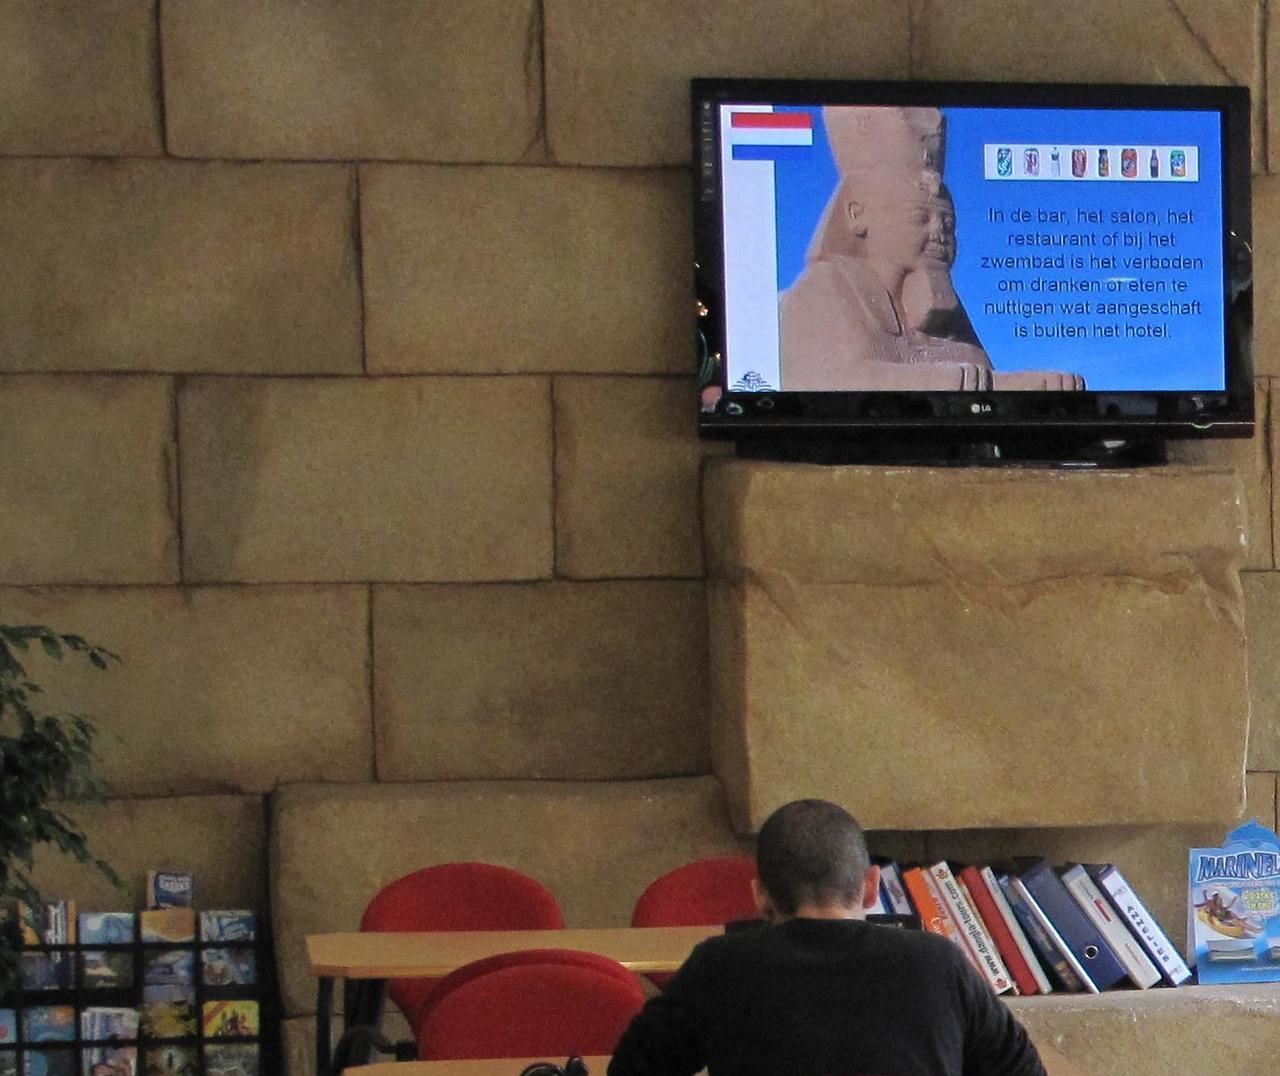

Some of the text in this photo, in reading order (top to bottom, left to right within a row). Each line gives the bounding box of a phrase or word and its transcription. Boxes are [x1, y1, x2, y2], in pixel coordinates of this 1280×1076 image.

[989, 208, 1194, 225] In de bar, het salon, het
[1008, 232, 1175, 250] restaurant of bij het
[981, 255, 1204, 270] zwembad is het verboden
[998, 280, 1024, 292] om
[1030, 278, 1100, 292] dranken
[1129, 279, 1166, 292] eten
[1172, 279, 1188, 292] te
[984, 300, 1202, 318] nuttigen wat aangeschaft
[1014, 323, 1172, 338] is buiten het hotel.
